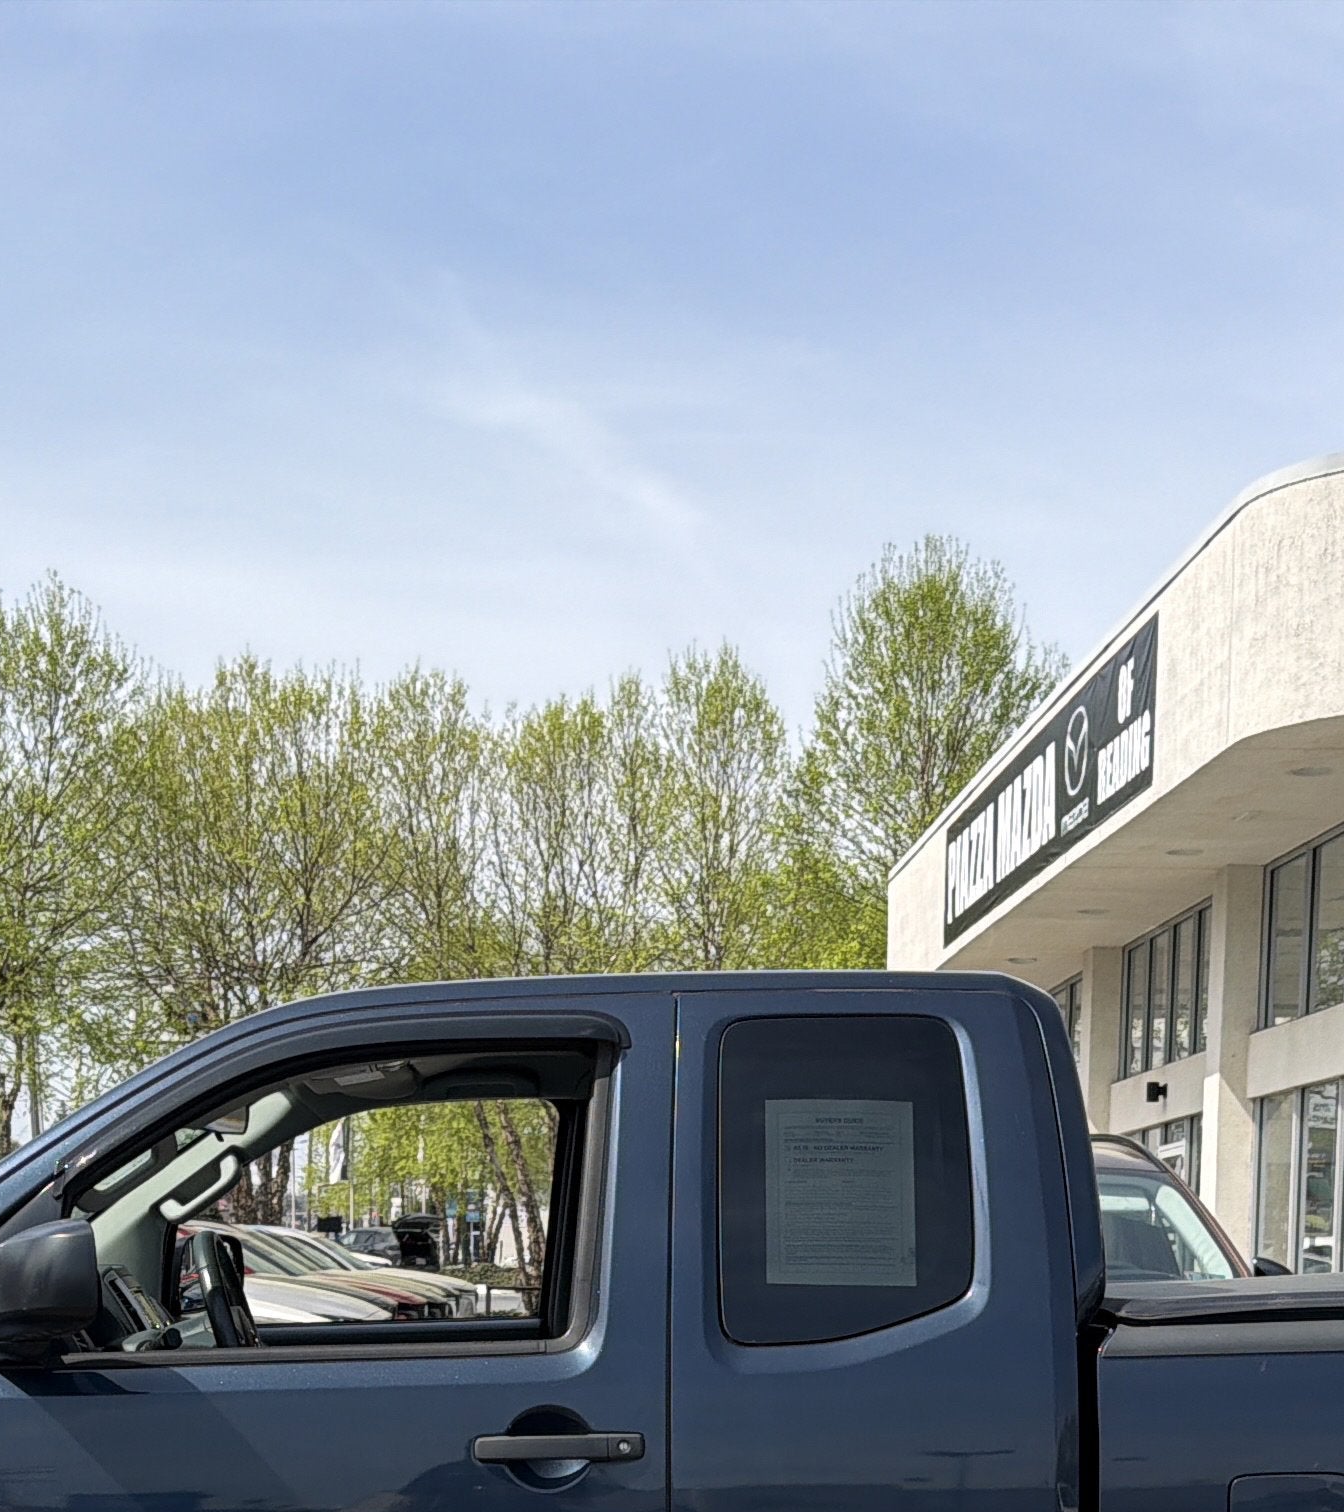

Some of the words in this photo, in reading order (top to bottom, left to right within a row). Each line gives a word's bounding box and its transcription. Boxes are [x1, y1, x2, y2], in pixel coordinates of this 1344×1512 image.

[1118, 655, 1134, 724] OF
[1097, 709, 1151, 806] READING
[947, 802, 995, 925] PIAZZA
[996, 741, 1056, 883] MAZDA
